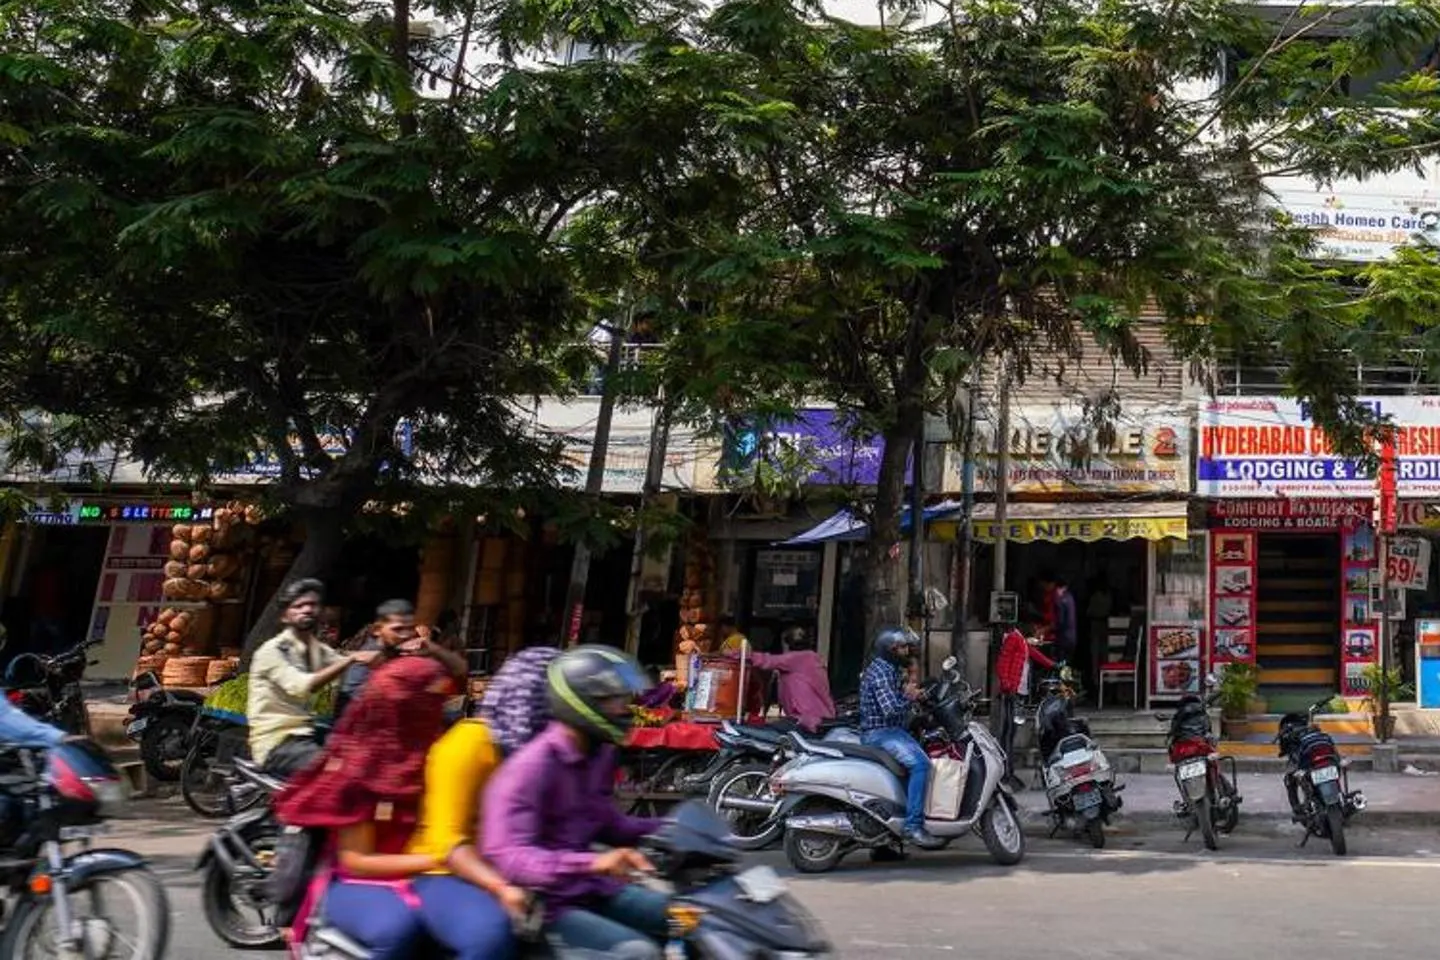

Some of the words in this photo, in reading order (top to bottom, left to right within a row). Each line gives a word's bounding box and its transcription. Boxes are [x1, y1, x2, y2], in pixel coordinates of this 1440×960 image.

[1335, 213, 1386, 228] Homeo
[1391, 216, 1427, 230] Care
[1153, 426, 1177, 457] 2
[1202, 425, 1306, 456] HYDERABAD
[1226, 461, 1325, 479] LODGING
[1331, 461, 1348, 479] &
[80, 506, 100, 517] NO
[1216, 500, 1285, 516] COMFORT
[1035, 523, 1092, 538] NILE
[1103, 523, 1119, 537] 2
[1224, 518, 1281, 528] LODGING
[1284, 518, 1294, 528] &
